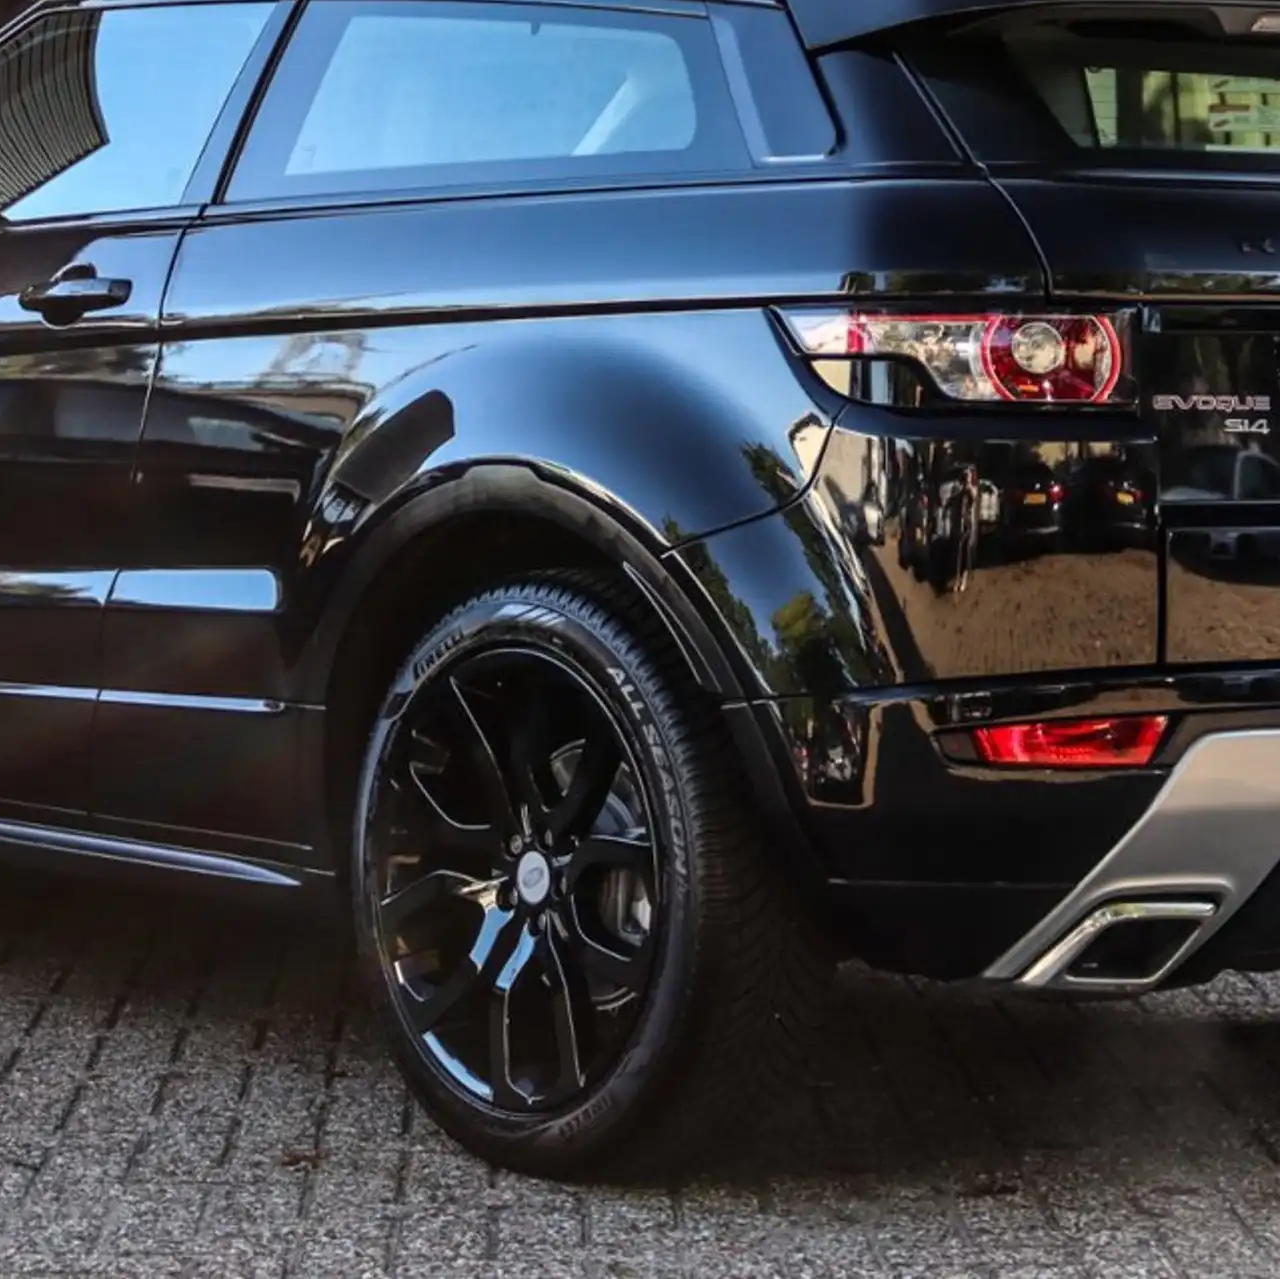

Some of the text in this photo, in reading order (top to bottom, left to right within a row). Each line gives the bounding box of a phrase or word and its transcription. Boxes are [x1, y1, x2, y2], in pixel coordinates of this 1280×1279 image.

[1152, 394, 1271, 412] EVOQUE
[605, 666, 688, 876] ALL SEASON
